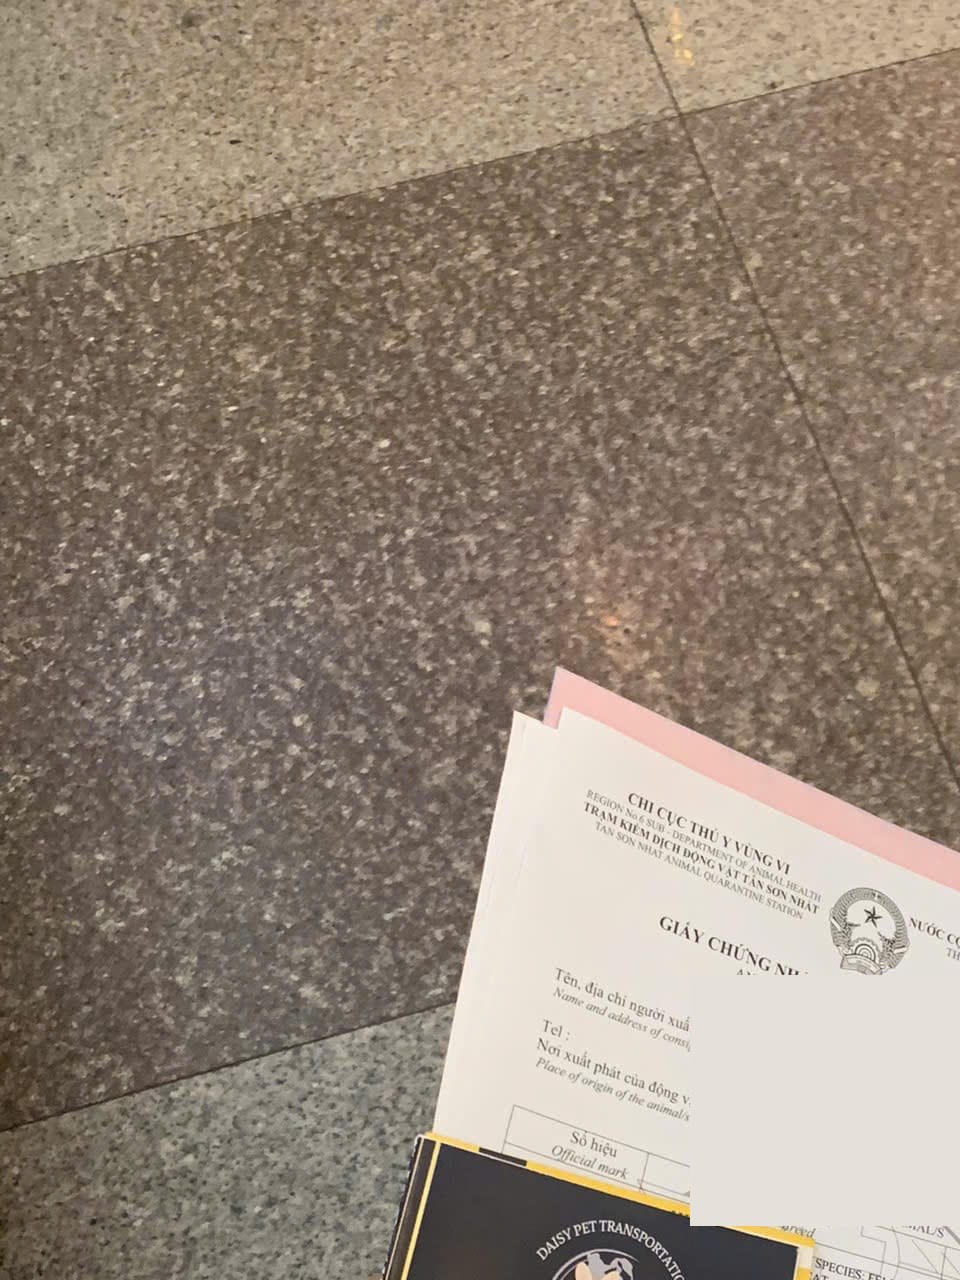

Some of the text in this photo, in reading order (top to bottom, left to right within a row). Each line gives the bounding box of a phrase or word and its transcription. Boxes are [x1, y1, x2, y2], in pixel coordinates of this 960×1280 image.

[584, 802, 617, 824] TRẠM
[628, 792, 654, 814] CHI
[657, 806, 688, 829] CỤC
[722, 835, 732, 848] Y
[777, 859, 790, 875] VI
[586, 789, 822, 902] REGION SUB DEPARTMENT OF ANIMAL HEALTH
[595, 821, 803, 920] TAN SON NHAT ANIMAL QUARANTINE STATION
[553, 987, 664, 1039] Name and address of
[555, 967, 581, 990] Tên,
[585, 981, 604, 999] địa
[629, 999, 665, 1023] người
[542, 1019, 563, 1038] Tel
[535, 1057, 567, 1077] Place
[568, 1072, 581, 1083] of
[582, 1077, 614, 1093] origin
[615, 1090, 628, 1101] of
[628, 1093, 645, 1107] the
[537, 1037, 561, 1057] Nơi
[563, 1051, 591, 1069] xuất
[593, 1062, 621, 1081] phát
[648, 1081, 679, 1104] động
[552, 1144, 629, 1180] Official mark
[590, 1137, 618, 1158] hiệu
[535, 1227, 572, 1261] DAISY
[573, 1220, 598, 1237] PET
[815, 1257, 865, 1280] SPECIES:
